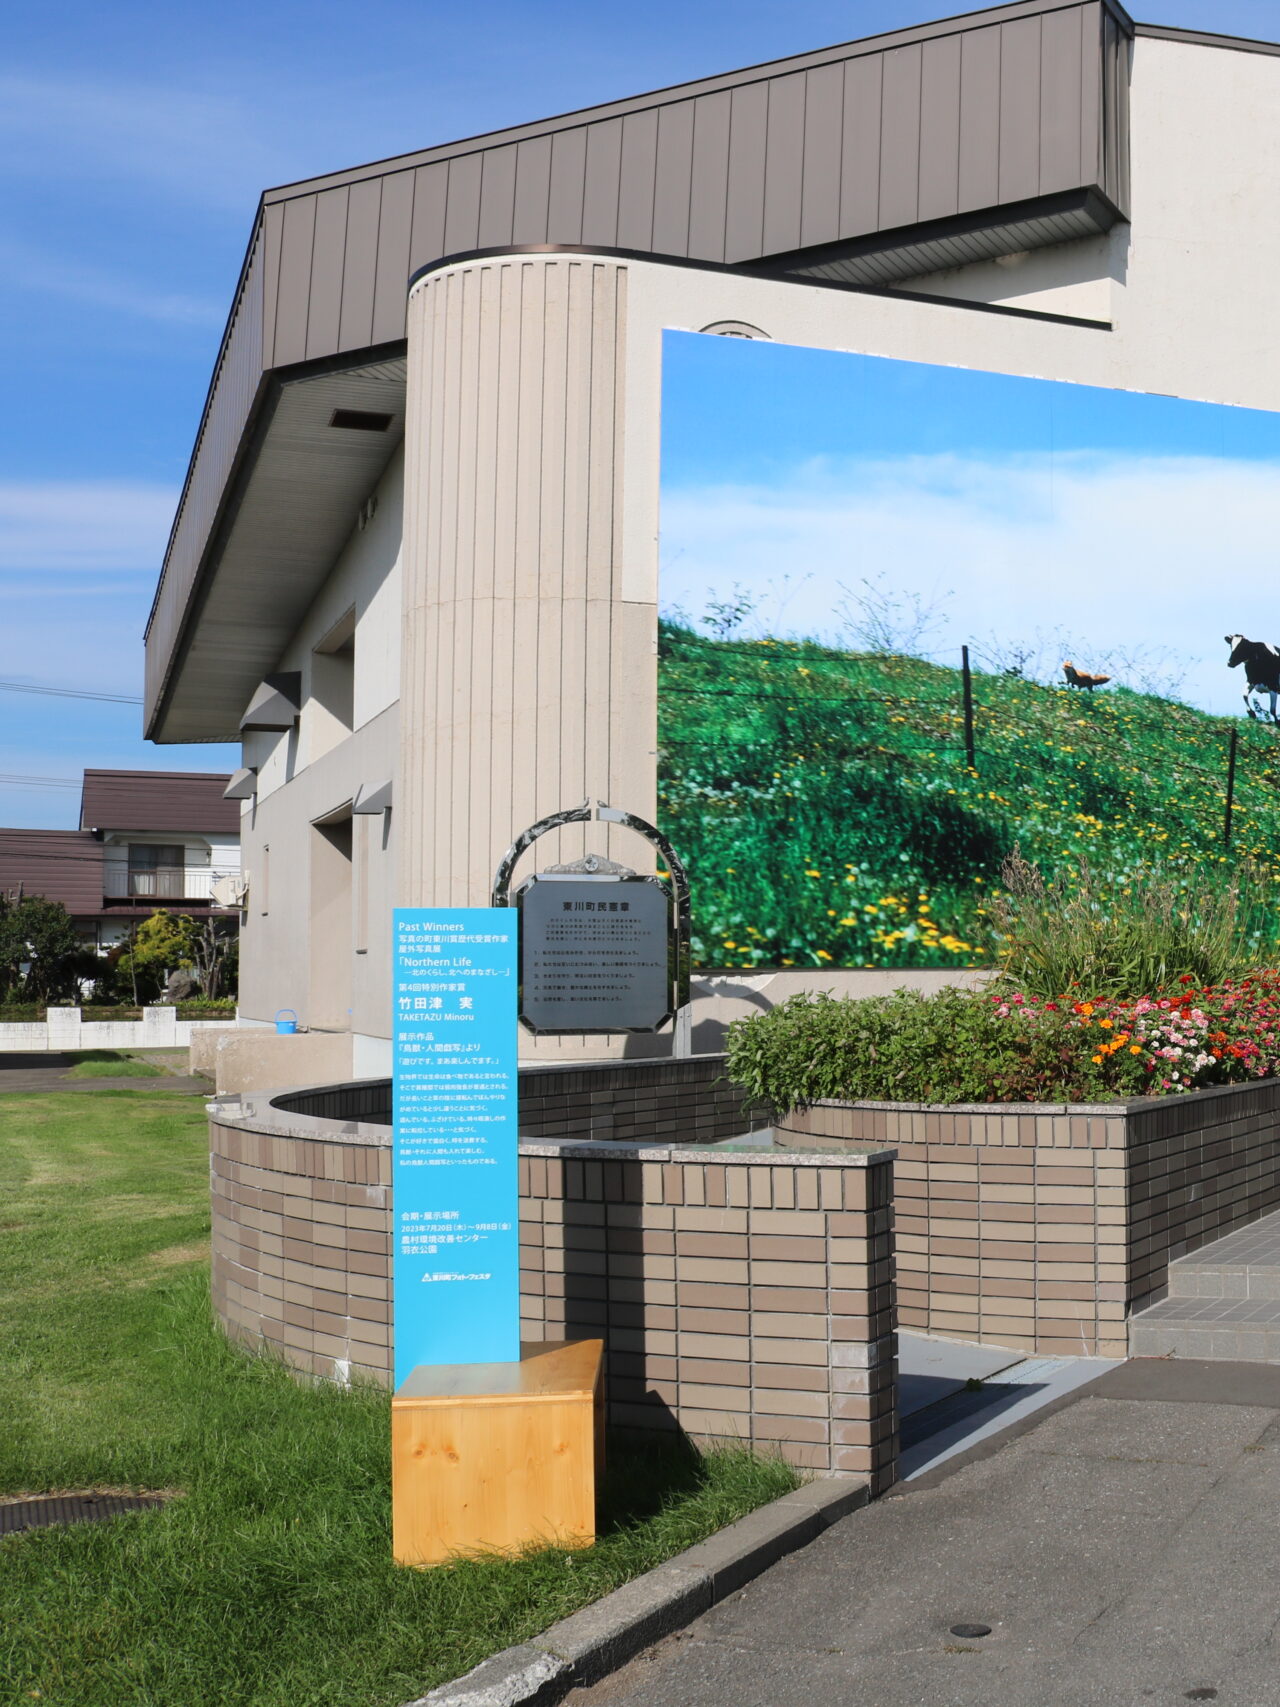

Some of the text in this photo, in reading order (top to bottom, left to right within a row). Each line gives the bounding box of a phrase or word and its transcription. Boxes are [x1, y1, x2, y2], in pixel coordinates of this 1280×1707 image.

[563, 901, 629, 912] 東川町民憲章
[399, 922, 464, 931] Past Winners
[453, 957, 472, 966] Life
[399, 983, 465, 992] 第4回特別作家賞
[398, 997, 473, 1009] 竹田津 実
[398, 1013, 474, 1021] TAKETAZU Minoru
[399, 1032, 434, 1041] 展示作品
[401, 1211, 459, 1221] 会期・展示場所
[401, 1234, 488, 1244] 農村環境改善センター
